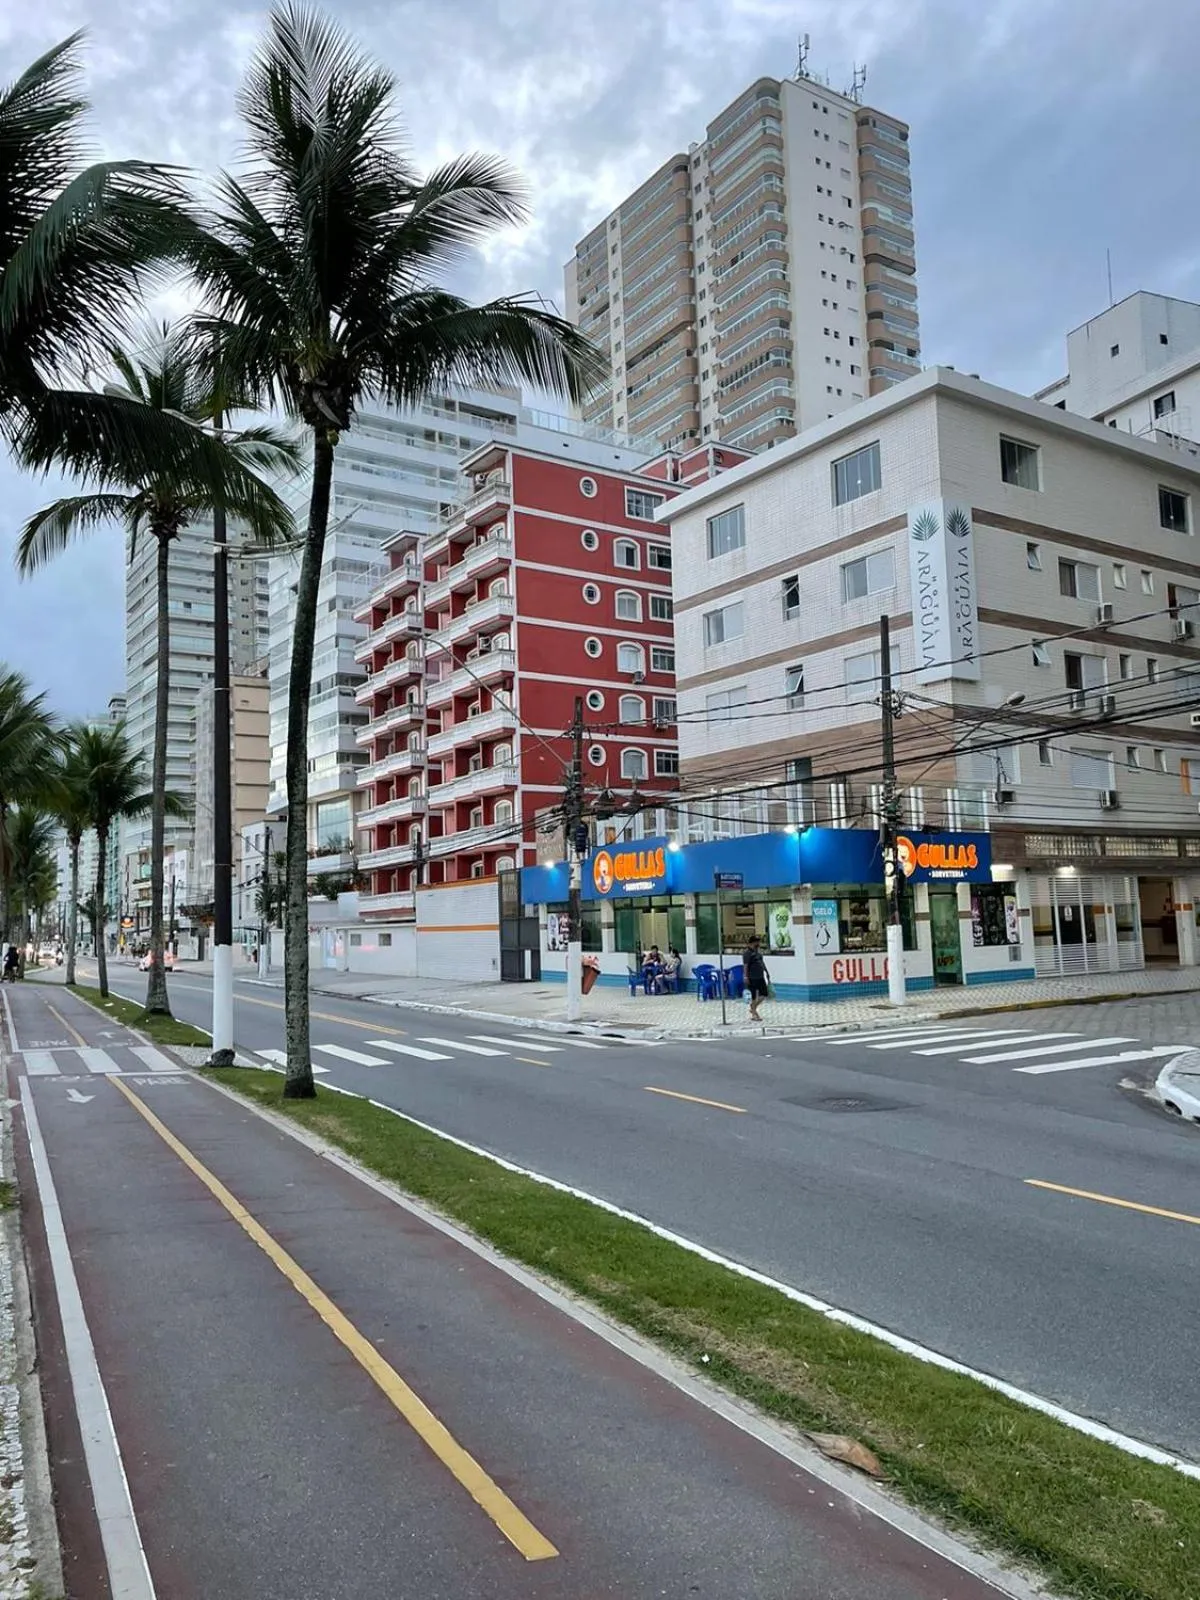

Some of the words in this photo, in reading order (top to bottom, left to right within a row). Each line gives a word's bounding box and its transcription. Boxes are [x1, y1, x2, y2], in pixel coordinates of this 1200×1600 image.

[918, 550, 935, 667] ARAGUAIA
[958, 547, 974, 665] ARAGUAIA
[614, 847, 665, 881] GULLAS
[916, 843, 978, 868] GULLAS
[833, 957, 906, 983] GULL
